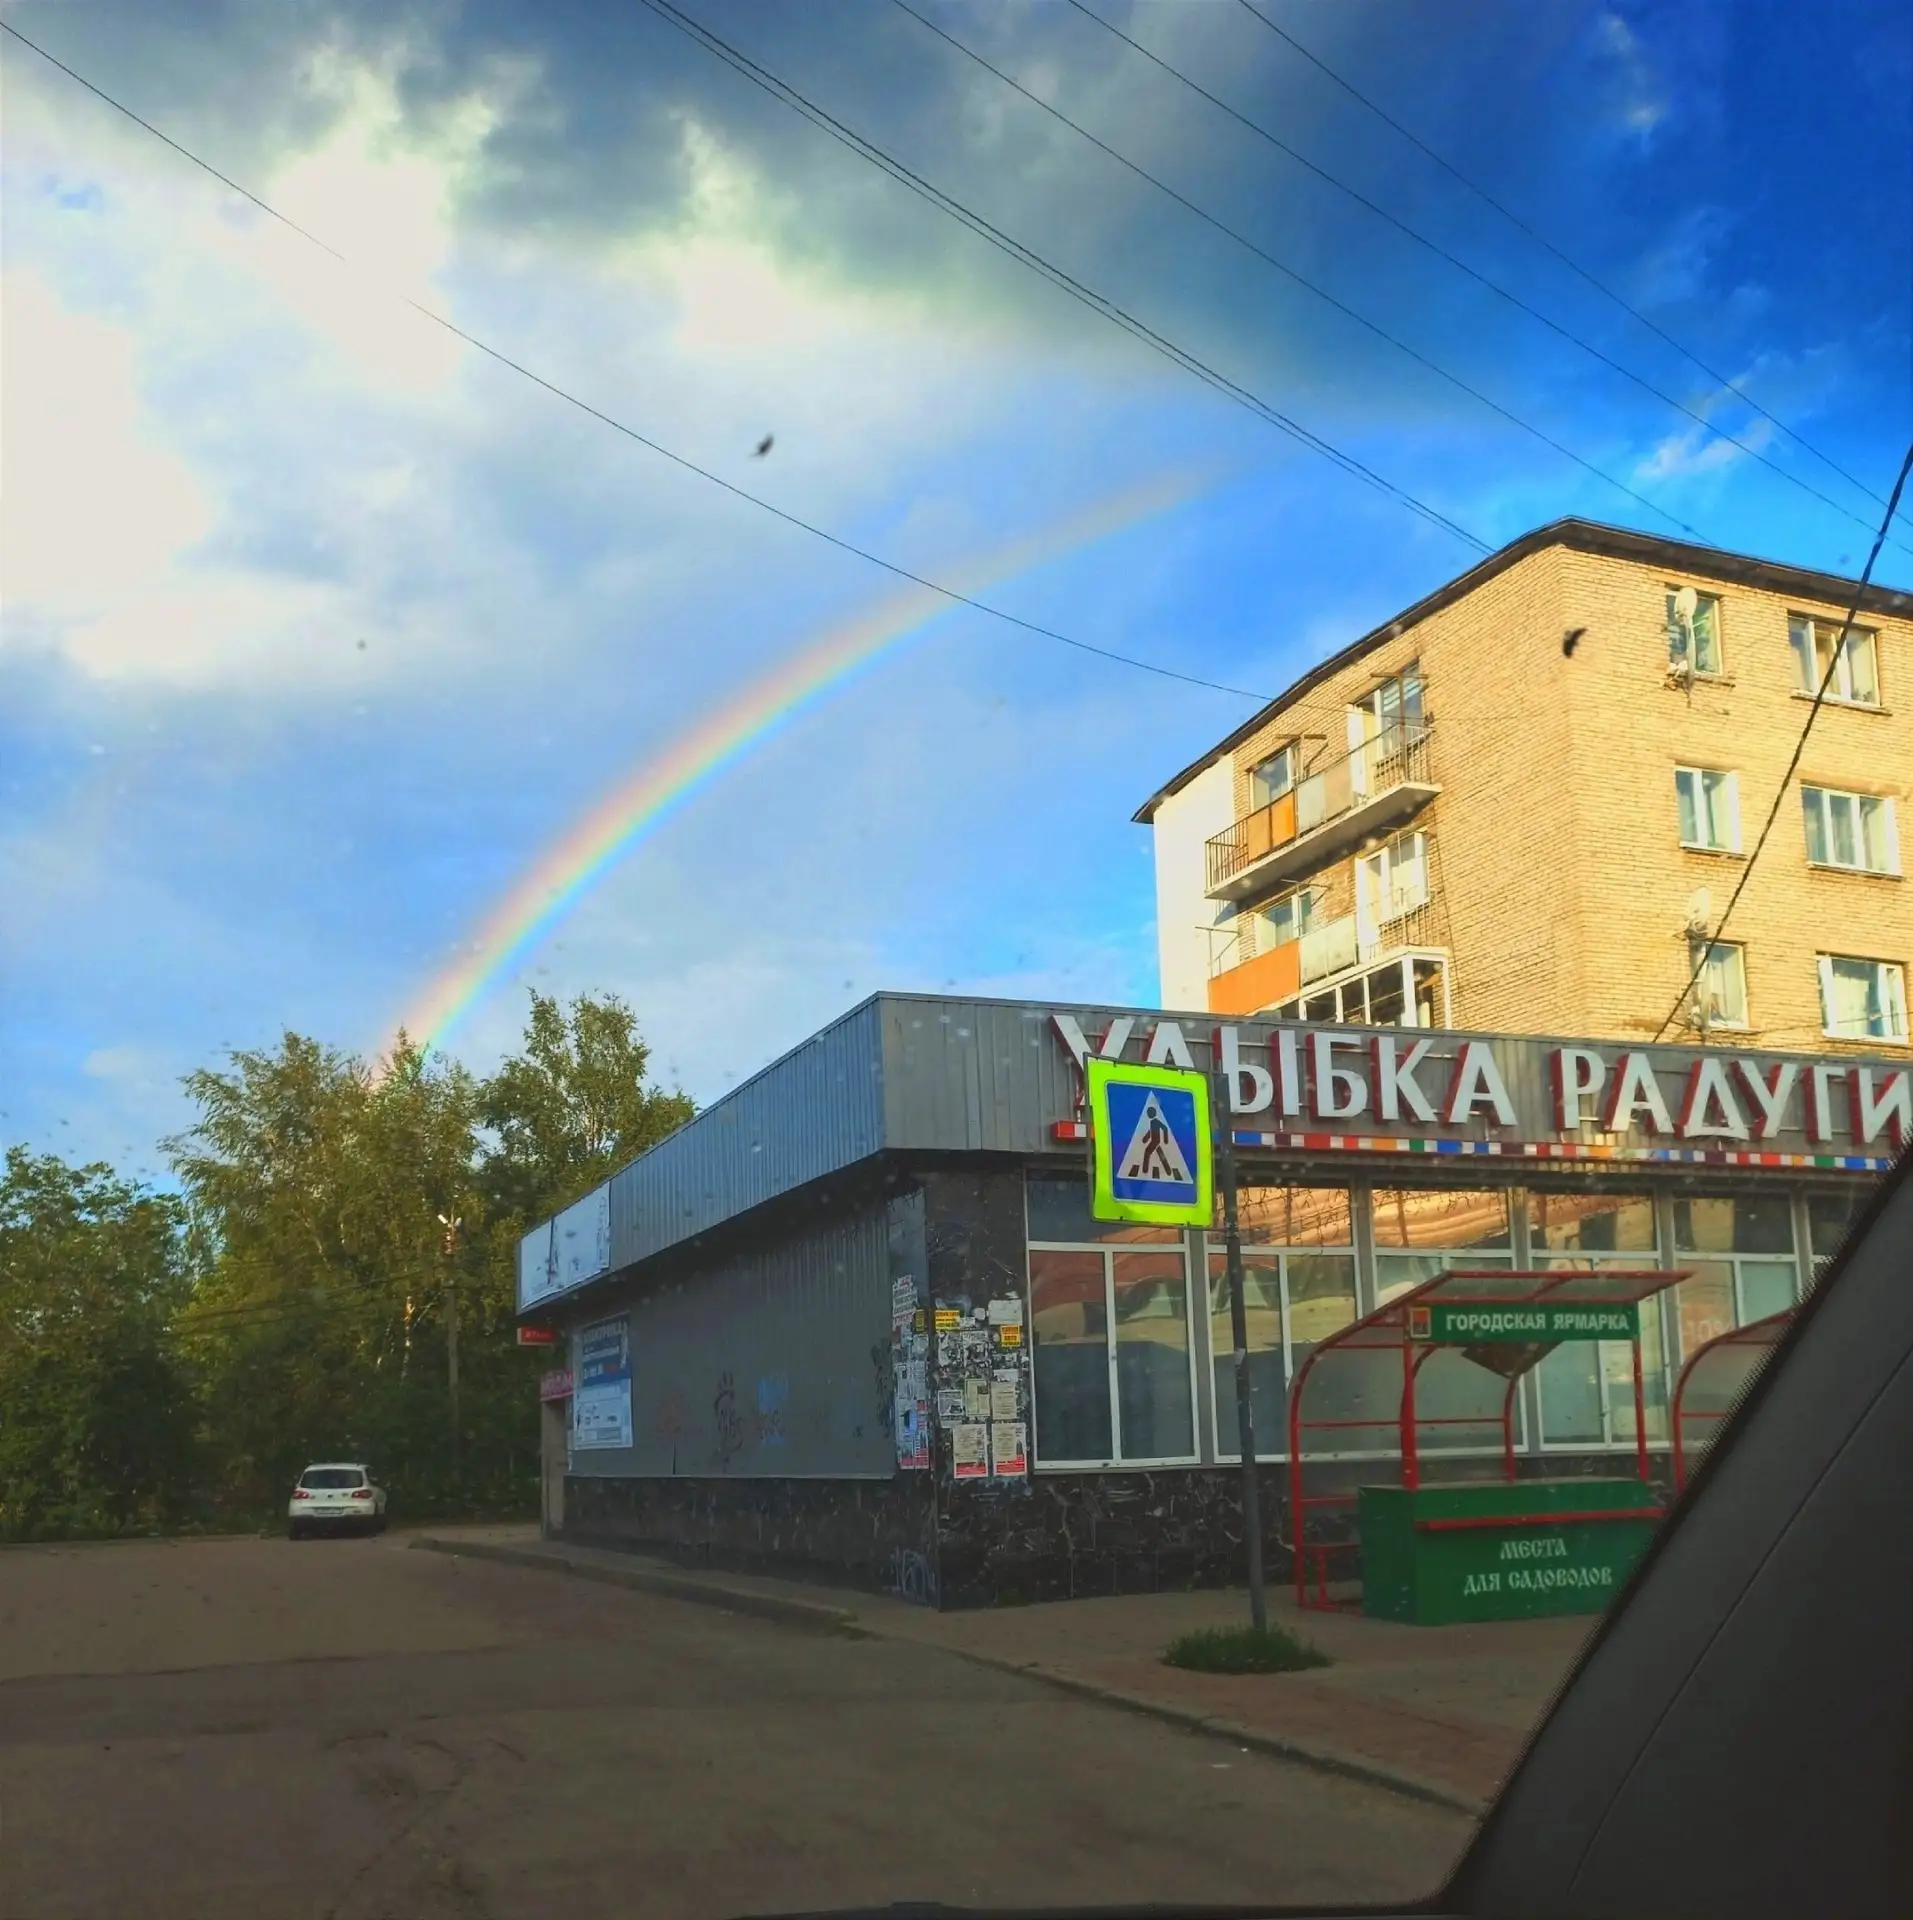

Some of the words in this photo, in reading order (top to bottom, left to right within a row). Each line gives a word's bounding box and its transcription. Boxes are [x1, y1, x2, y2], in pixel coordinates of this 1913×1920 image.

[1550, 1048, 1912, 1145] РАДУГИ
[1445, 1313, 1546, 1333] ГОРОДСКАЯ
[1553, 1312, 1630, 1332] ЯРМАРКА
[1500, 1537, 1568, 1560] МЕСТА
[1463, 1572, 1501, 1597] ДЛЯ
[1507, 1566, 1613, 1593] САДОВОДОВ
